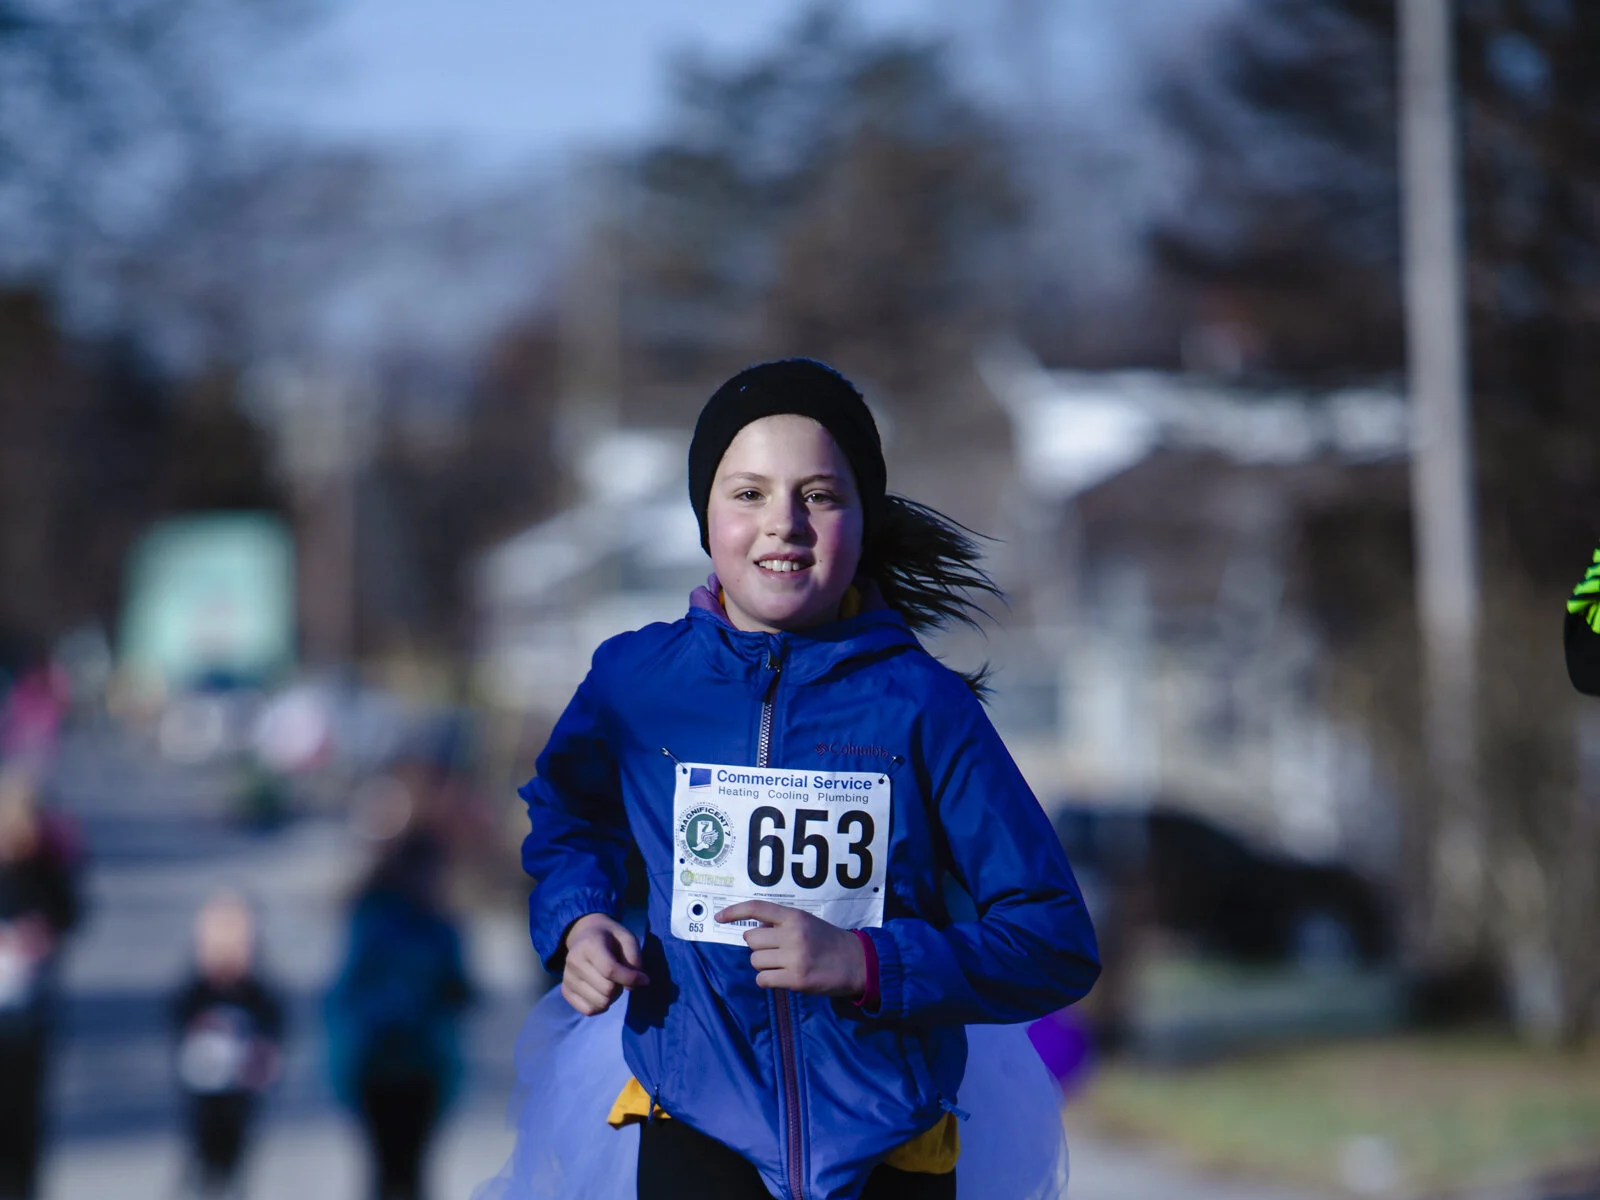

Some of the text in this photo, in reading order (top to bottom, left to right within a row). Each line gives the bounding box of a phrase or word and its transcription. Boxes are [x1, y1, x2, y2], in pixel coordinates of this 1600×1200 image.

[828, 742, 890, 758] Columbia
[716, 770, 873, 790] Commercial Service
[718, 786, 869, 804] Heating Cooling Plumbing
[680, 807, 729, 833] MAGNIFICENT
[747, 805, 875, 889] 653
[689, 923, 704, 933] 653
